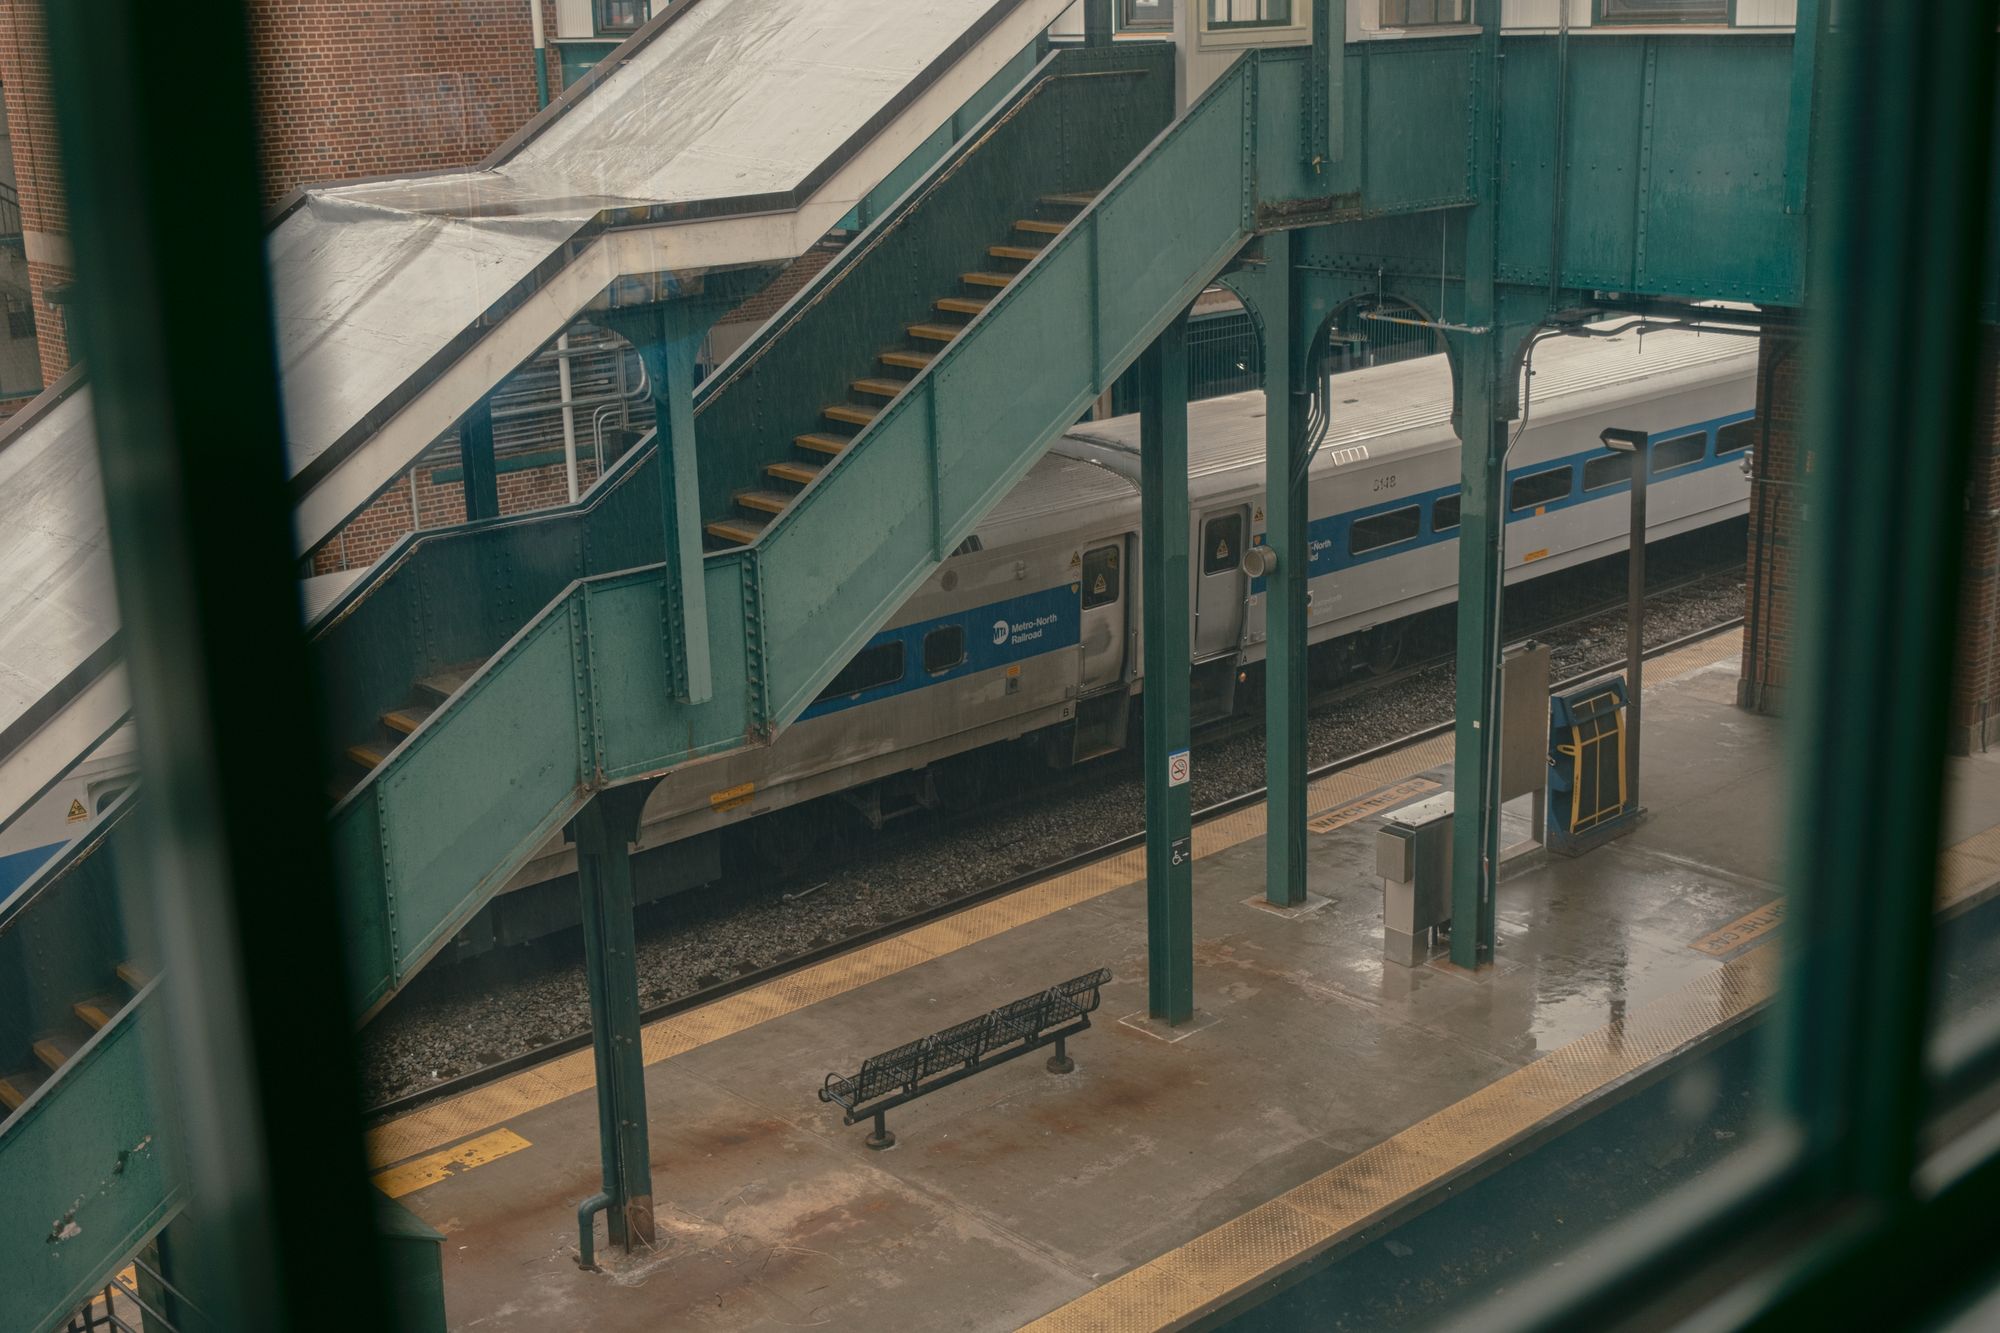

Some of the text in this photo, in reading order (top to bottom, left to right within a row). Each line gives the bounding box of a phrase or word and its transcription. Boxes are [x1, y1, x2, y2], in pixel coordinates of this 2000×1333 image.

[1011, 613, 1057, 634] Metro-North
[1011, 628, 1042, 645] Railroad
[1363, 793, 1397, 808] THE
